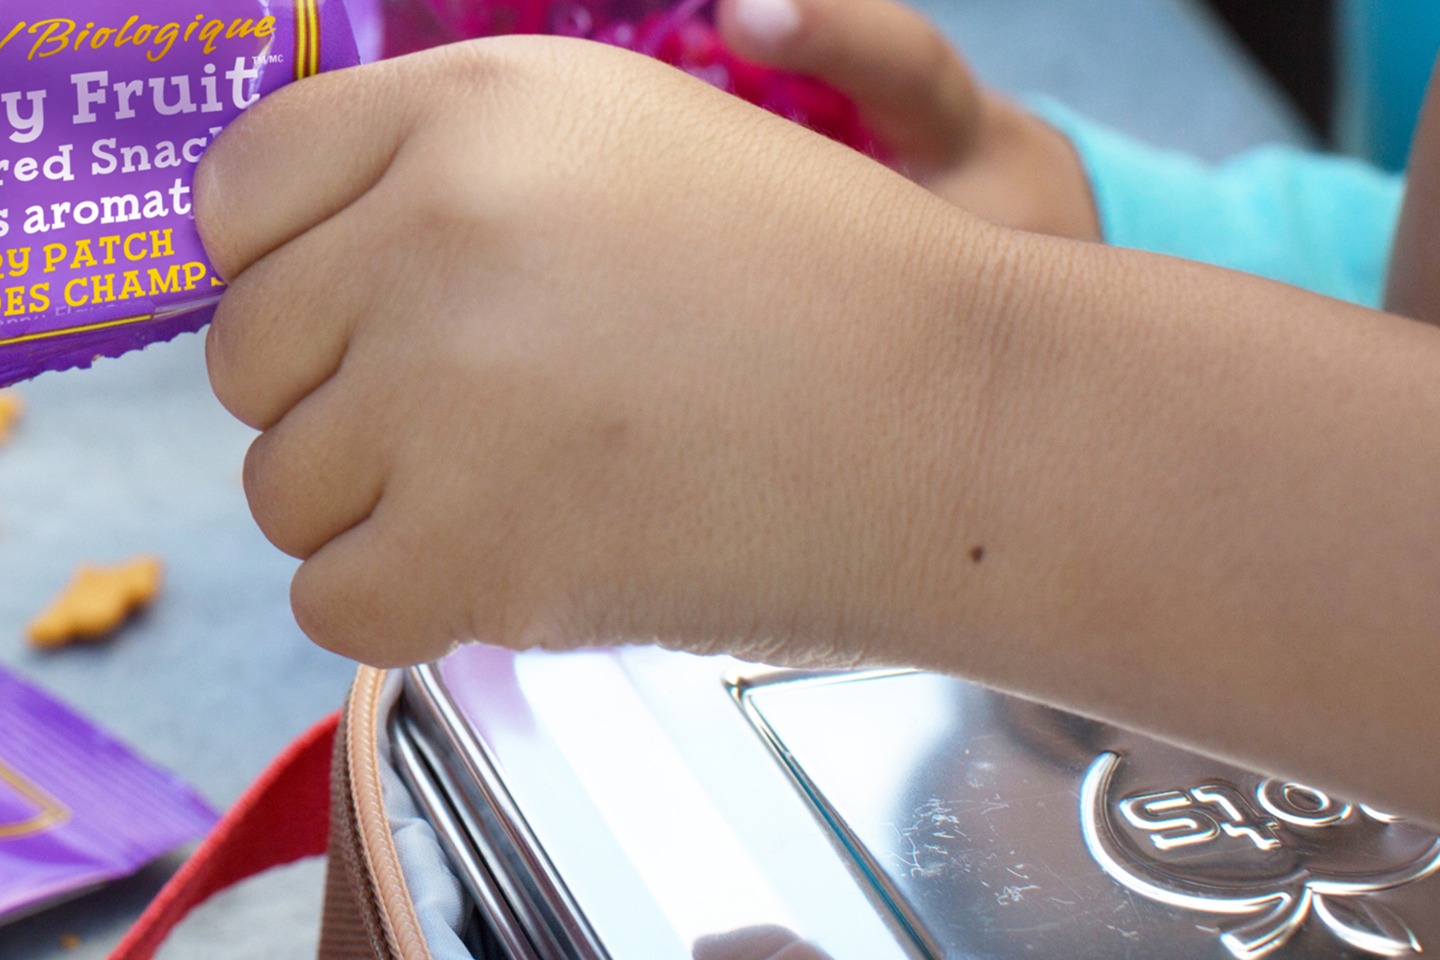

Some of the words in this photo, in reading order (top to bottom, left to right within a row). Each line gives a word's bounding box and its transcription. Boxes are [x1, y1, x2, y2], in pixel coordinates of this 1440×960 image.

[71, 56, 260, 125] Fruit
[91, 126, 223, 176] Snac
[23, 178, 193, 236] aromat
[43, 228, 175, 273] PATCH
